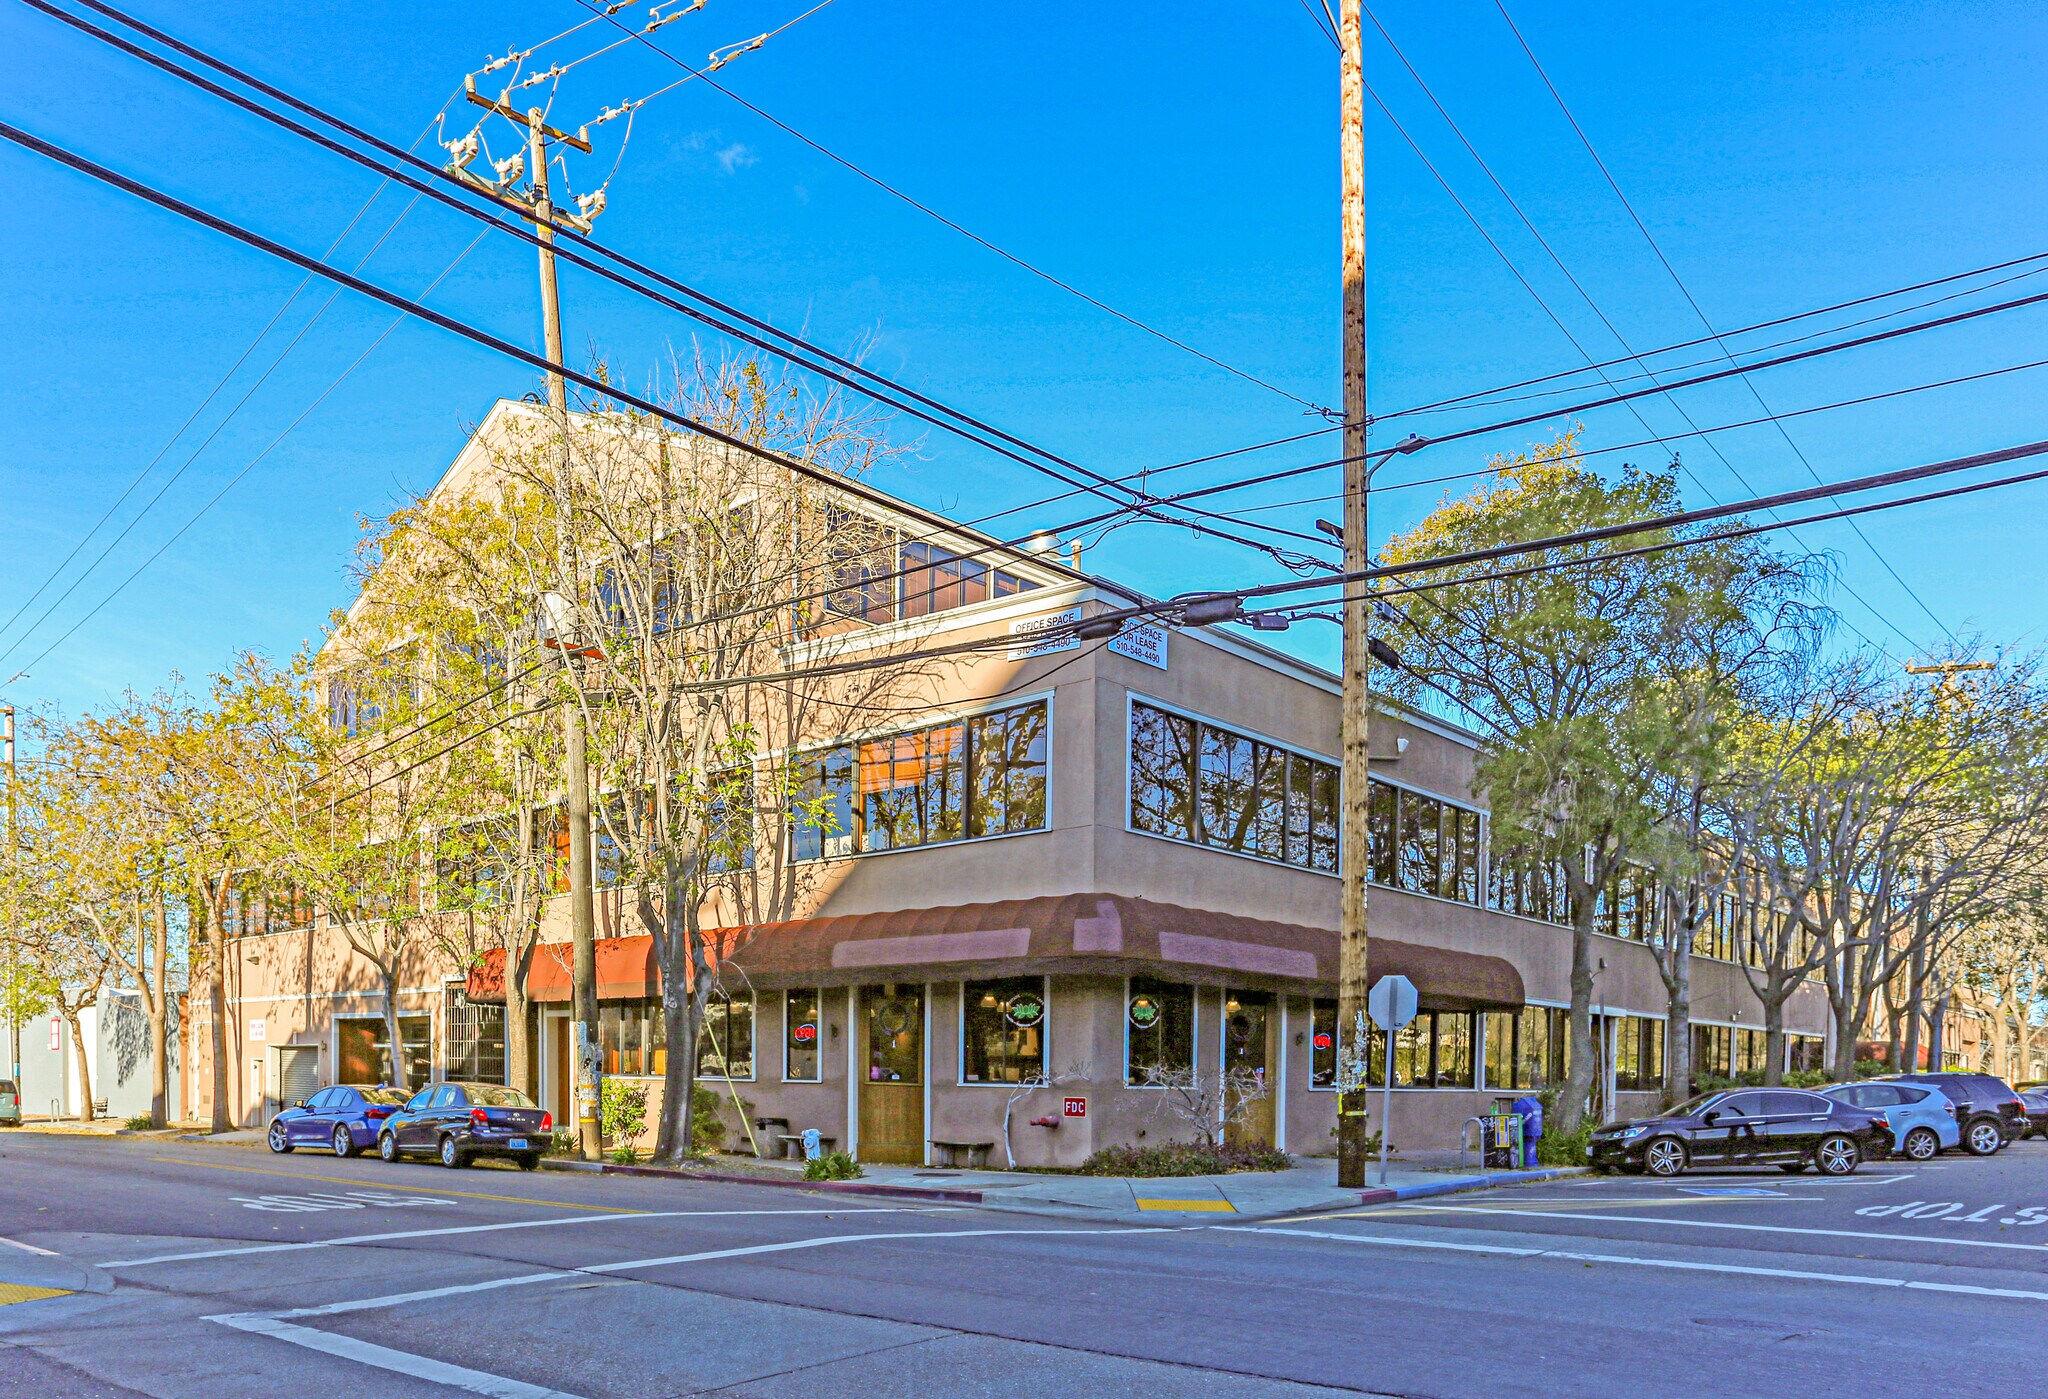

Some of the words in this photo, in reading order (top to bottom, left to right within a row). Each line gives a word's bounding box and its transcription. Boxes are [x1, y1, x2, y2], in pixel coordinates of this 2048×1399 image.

[1015, 618, 1045, 633] OFFICE
[1046, 612, 1075, 627] SPACE
[1140, 625, 1163, 642] SPACE
[1135, 635, 1157, 651] LEASE
[1116, 640, 1160, 664] 510-548-4490
[794, 1027, 817, 1039] OPEN
[1065, 1101, 1085, 1113] FDC
[1854, 1201, 2048, 1225] STOP
